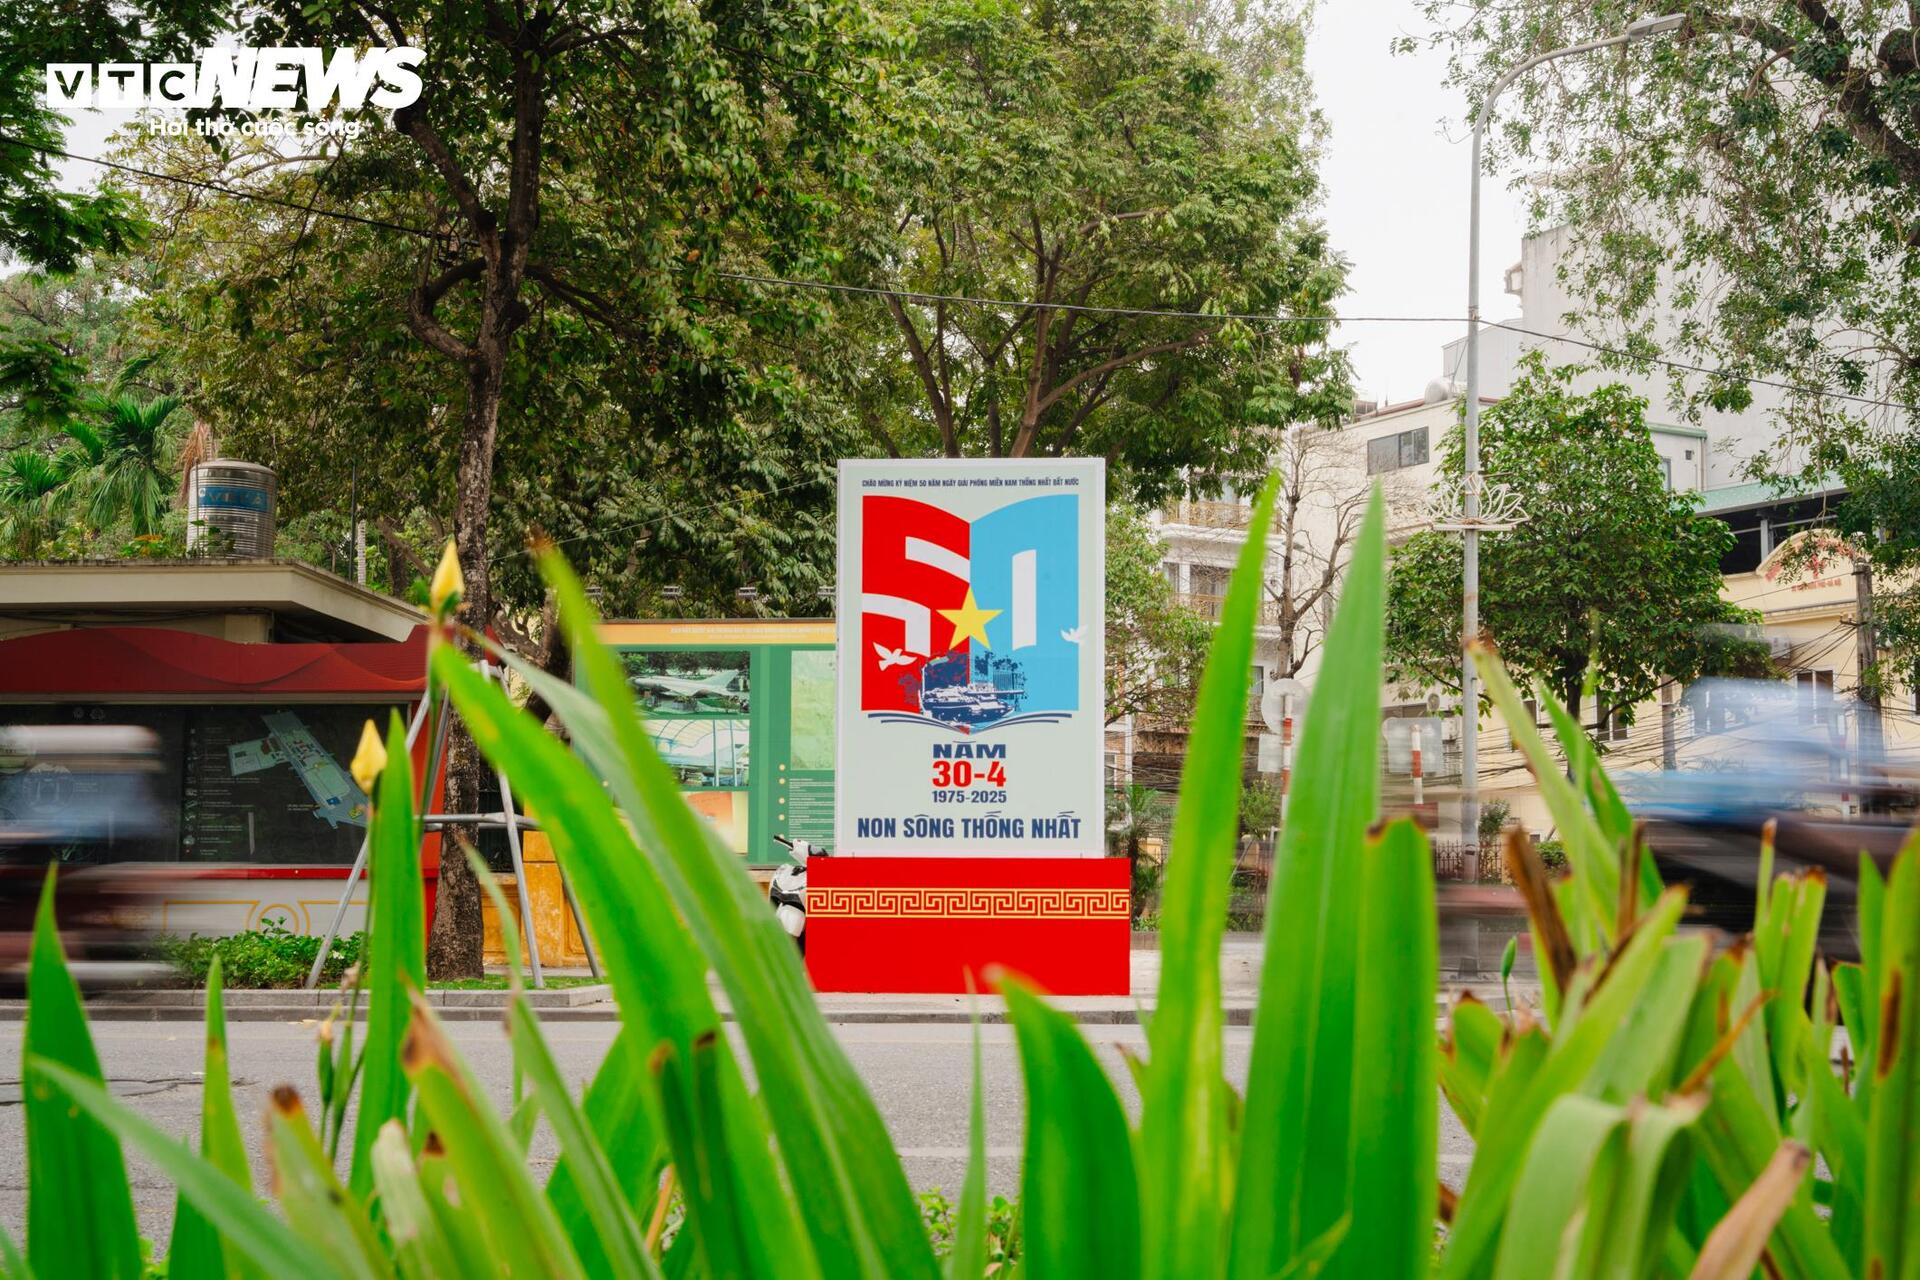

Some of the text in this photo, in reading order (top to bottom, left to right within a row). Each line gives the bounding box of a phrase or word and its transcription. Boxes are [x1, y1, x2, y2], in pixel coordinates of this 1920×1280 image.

[919, 479, 927, 487] 50
[1004, 479, 1018, 487] NAM
[932, 740, 1007, 759] NĂM
[932, 760, 1007, 787] 30-4
[932, 790, 1007, 803] 1975-2025
[857, 810, 1081, 838] NON SÔNG THỐNG NHẤT
